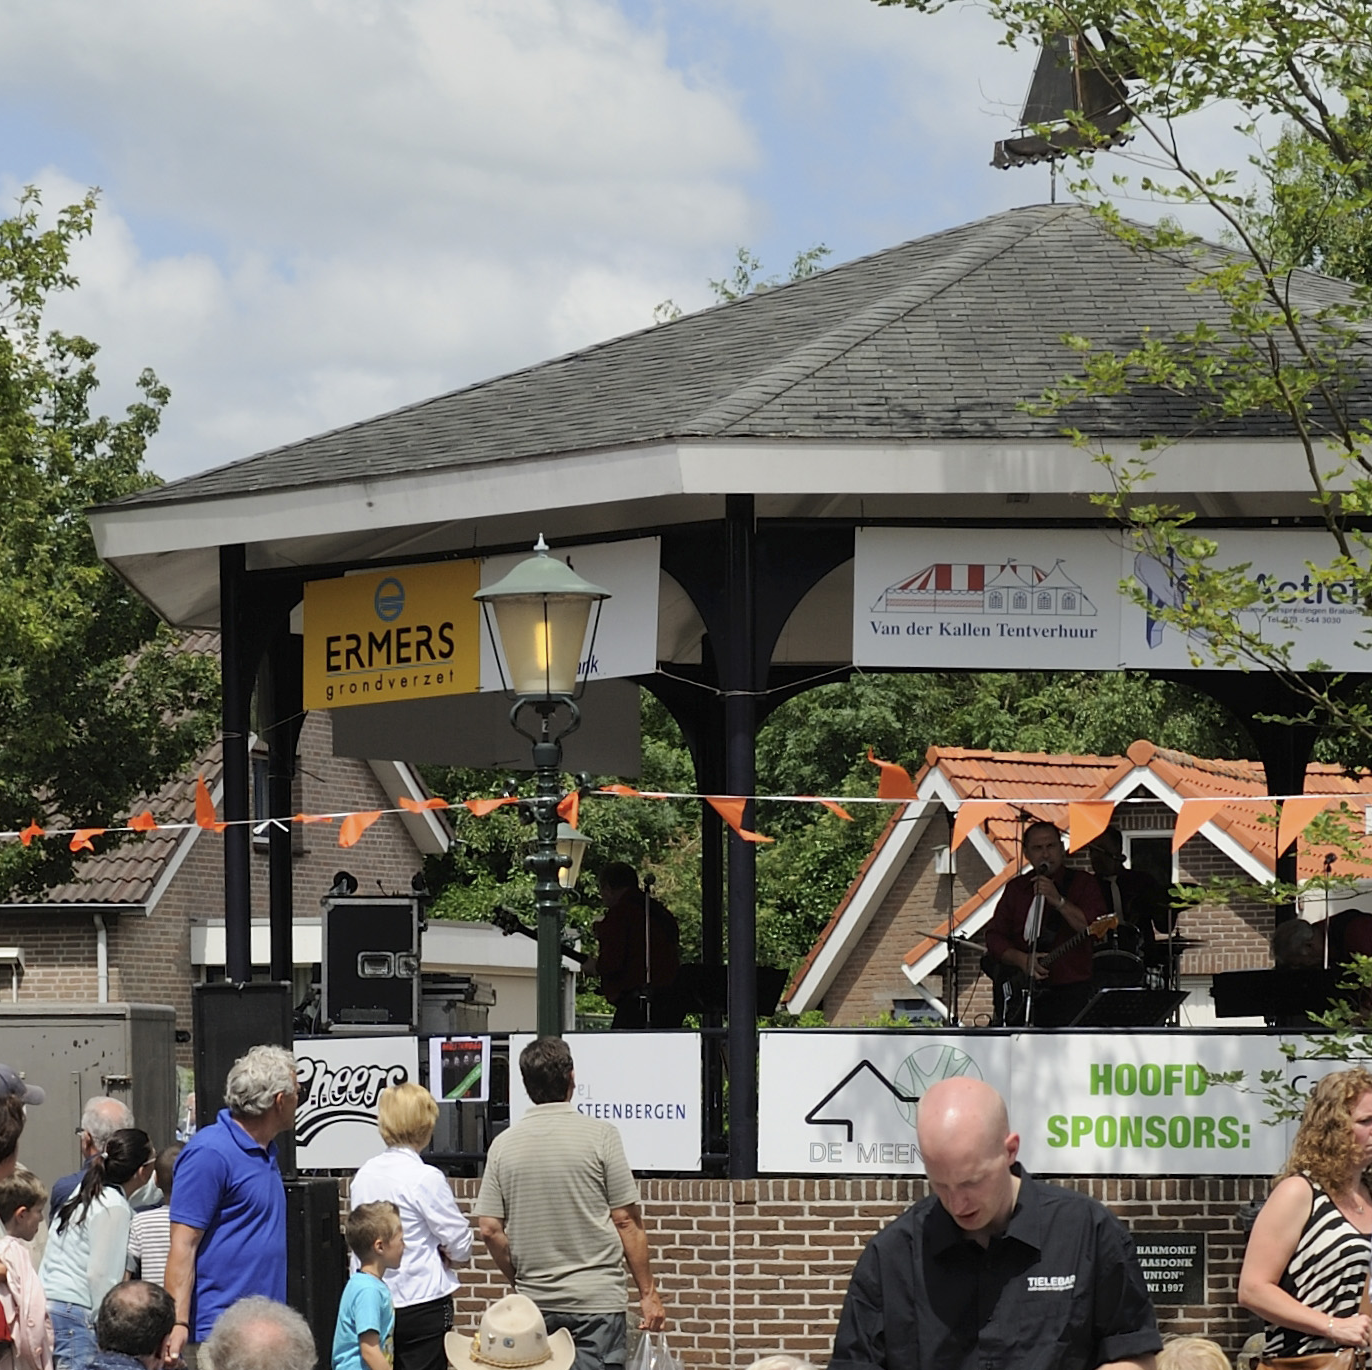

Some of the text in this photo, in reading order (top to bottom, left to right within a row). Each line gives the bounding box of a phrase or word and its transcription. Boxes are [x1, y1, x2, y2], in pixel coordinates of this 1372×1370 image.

[1268, 607, 1327, 615] erspreidingen
[870, 621, 1098, 638] Van der Kallen Tentverhuur
[326, 622, 454, 673] ERMERS
[326, 669, 455, 700] grondverzet
[1089, 1063, 1208, 1097] HOOFD
[577, 1103, 686, 1119] STEENBERGEN
[1047, 1115, 1251, 1149] SPONSORS:
[809, 1142, 926, 1163] DE MEEN
[1136, 1246, 1197, 1255] HARMONIE
[1138, 1258, 1194, 1267] AASDONK
[1162, 1283, 1184, 1292] 1997
